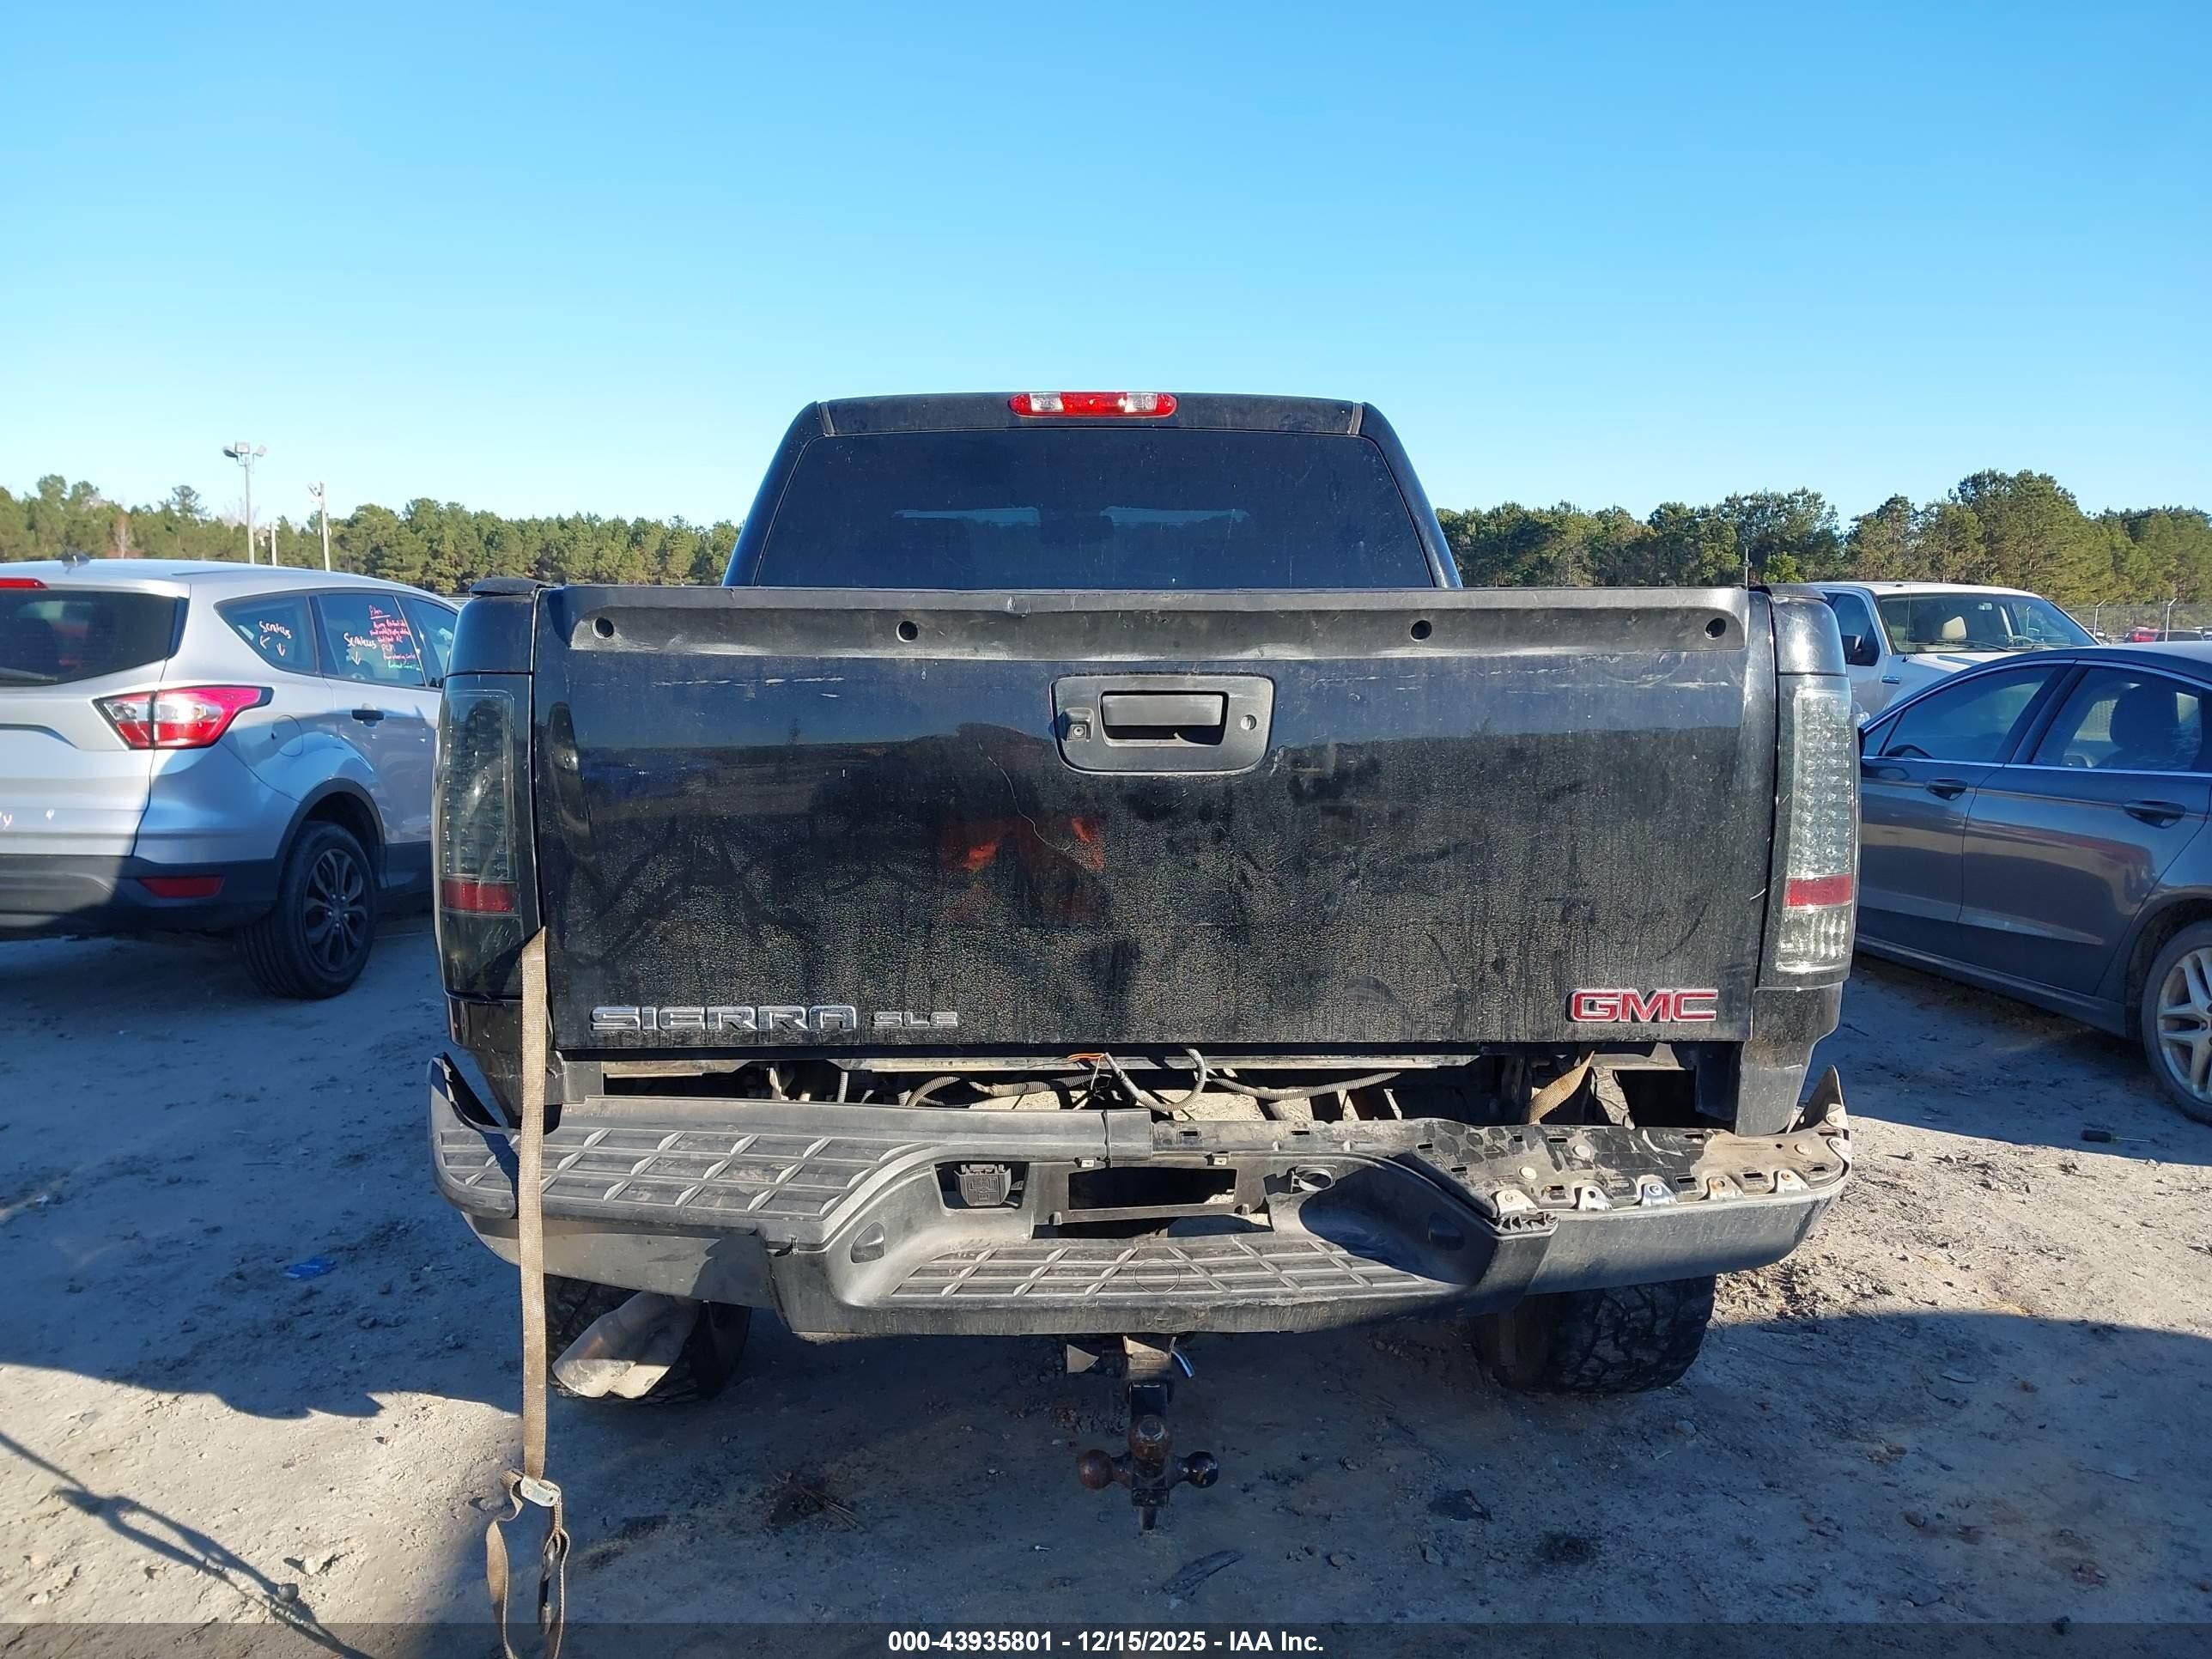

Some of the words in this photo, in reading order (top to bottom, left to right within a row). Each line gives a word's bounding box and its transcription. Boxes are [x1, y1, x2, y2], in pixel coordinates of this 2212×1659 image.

[590, 1005, 857, 1032] SIERRA
[872, 1010, 959, 1030] SLE
[1568, 988, 1719, 1023] GMC
